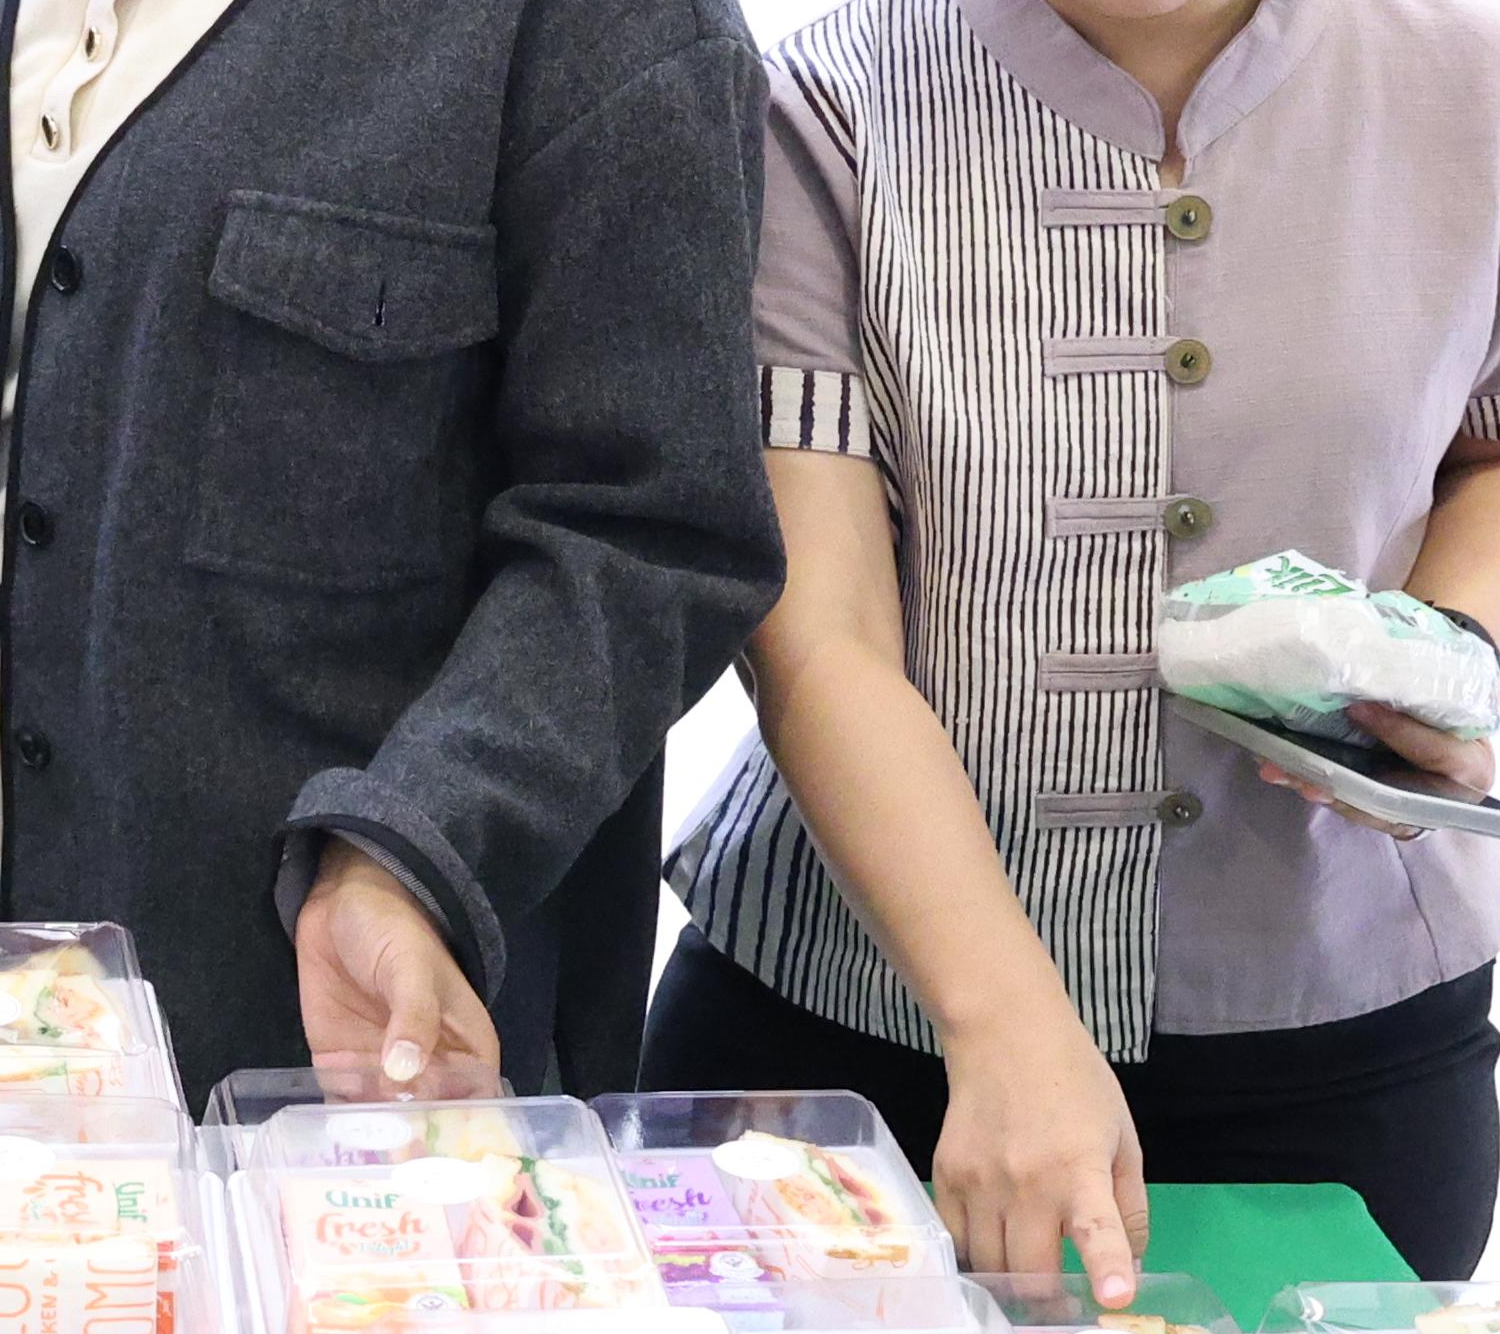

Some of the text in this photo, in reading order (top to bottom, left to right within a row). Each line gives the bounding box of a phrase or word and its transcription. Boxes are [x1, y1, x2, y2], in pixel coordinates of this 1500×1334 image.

[114, 1179, 148, 1225] Unif
[324, 1189, 402, 1210] Unif
[315, 1208, 427, 1244] fresh
